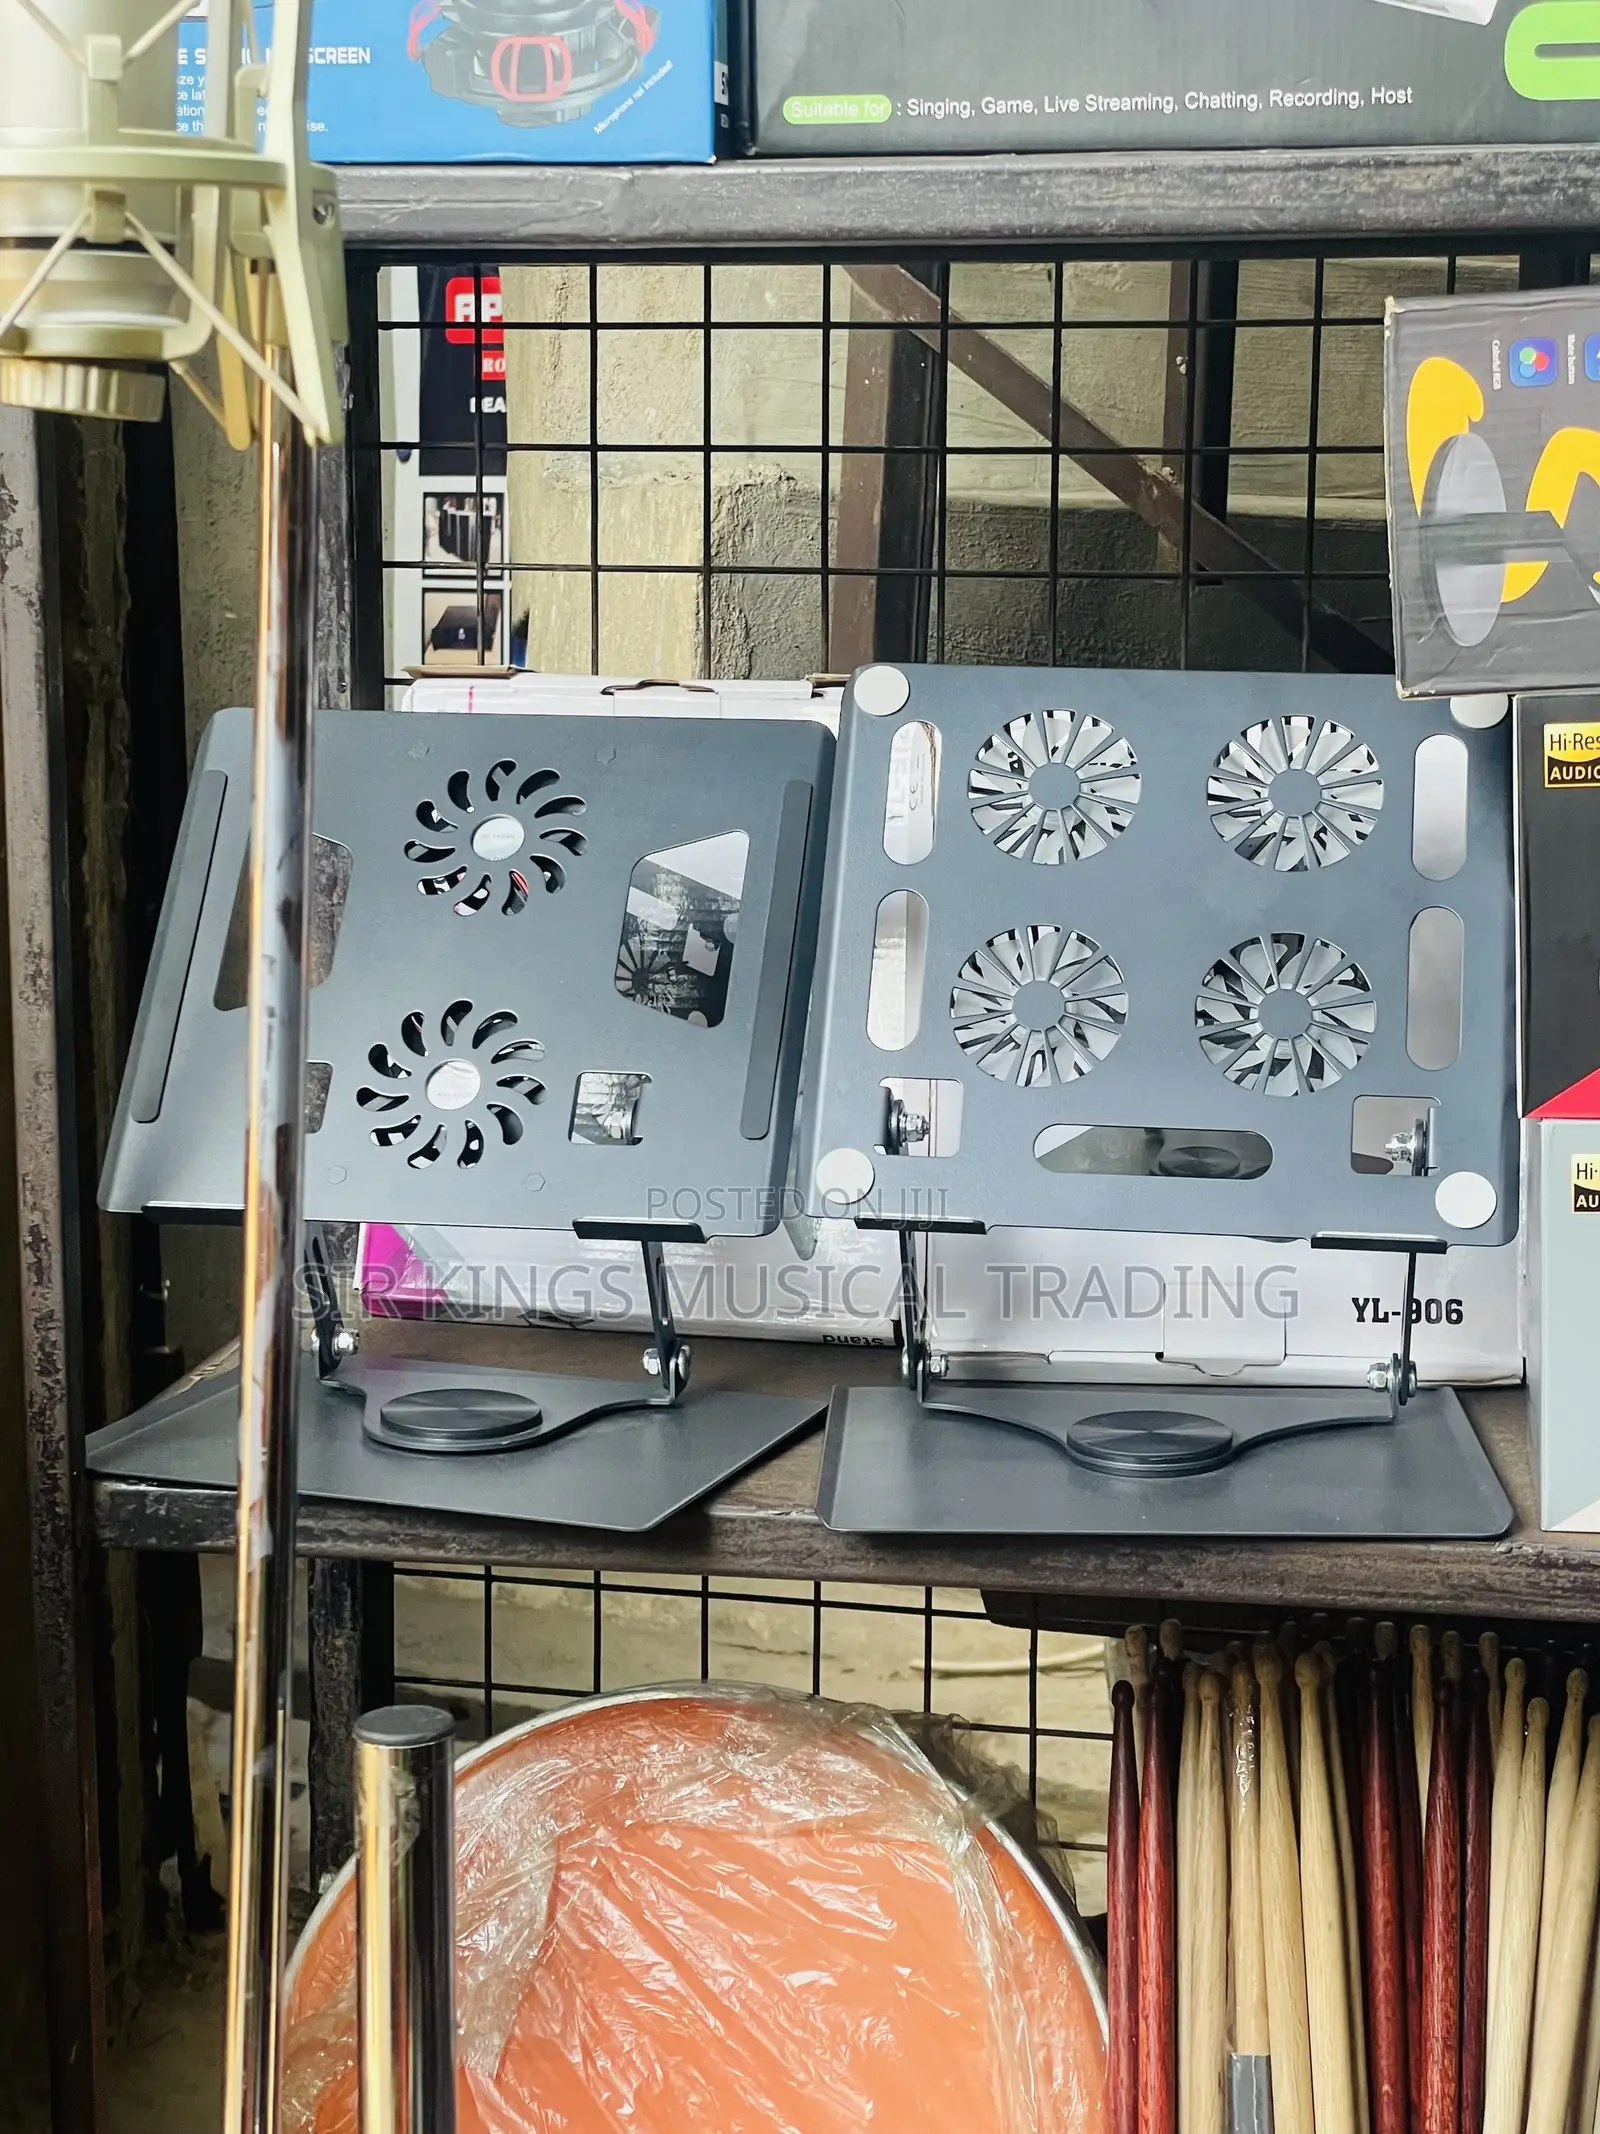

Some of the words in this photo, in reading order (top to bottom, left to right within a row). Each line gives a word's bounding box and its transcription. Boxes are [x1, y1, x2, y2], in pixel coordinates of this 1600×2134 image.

[791, 101, 858, 118] Suitable
[864, 101, 885, 117] for
[906, 97, 976, 119] Singing,
[981, 96, 1038, 115] Game,
[1044, 95, 1080, 113] Live
[1084, 93, 1178, 114] Streaming,
[1185, 91, 1262, 112] Chatting,
[1269, 88, 1364, 109] Recording,
[1371, 86, 1413, 105] Host
